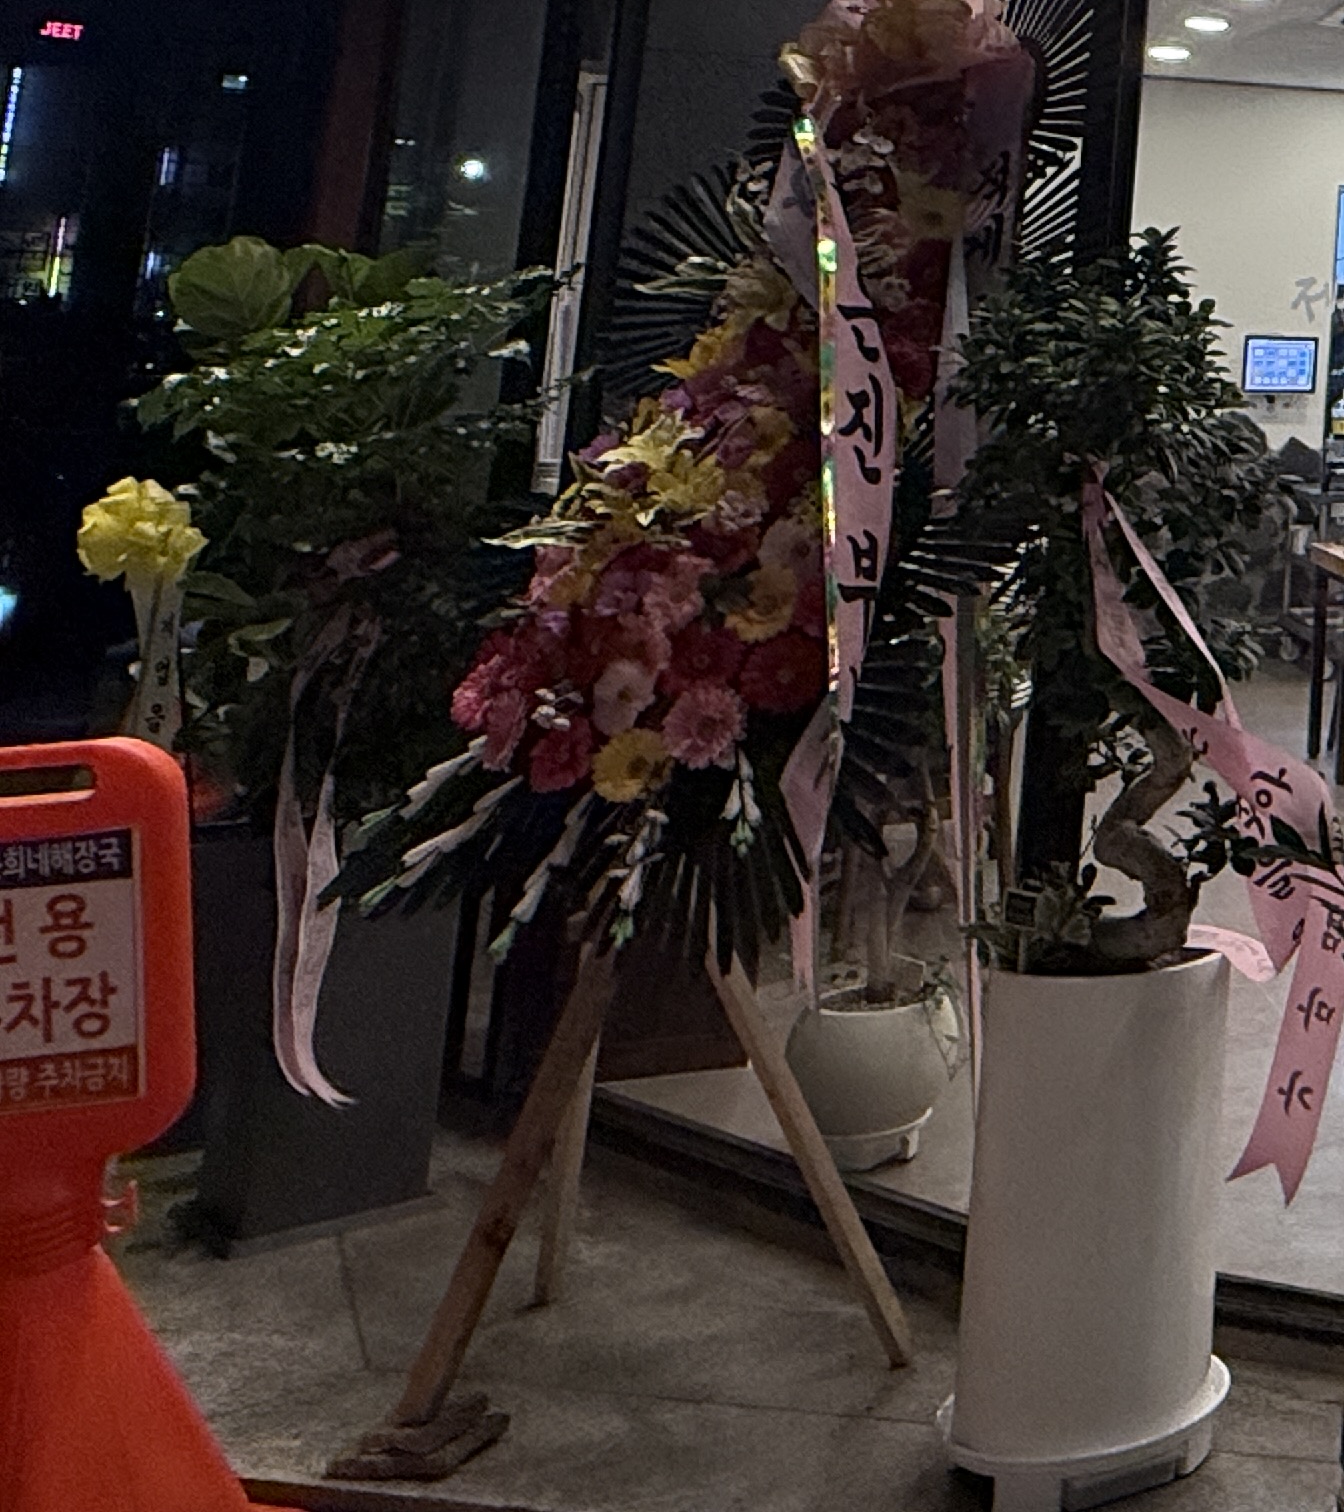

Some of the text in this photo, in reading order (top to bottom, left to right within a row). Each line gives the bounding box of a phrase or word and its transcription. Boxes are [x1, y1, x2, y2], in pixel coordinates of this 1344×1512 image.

[0, 838, 124, 880] 희네해장국
[0, 971, 118, 1044] 차장
[36, 1055, 129, 1099] 주차금지
